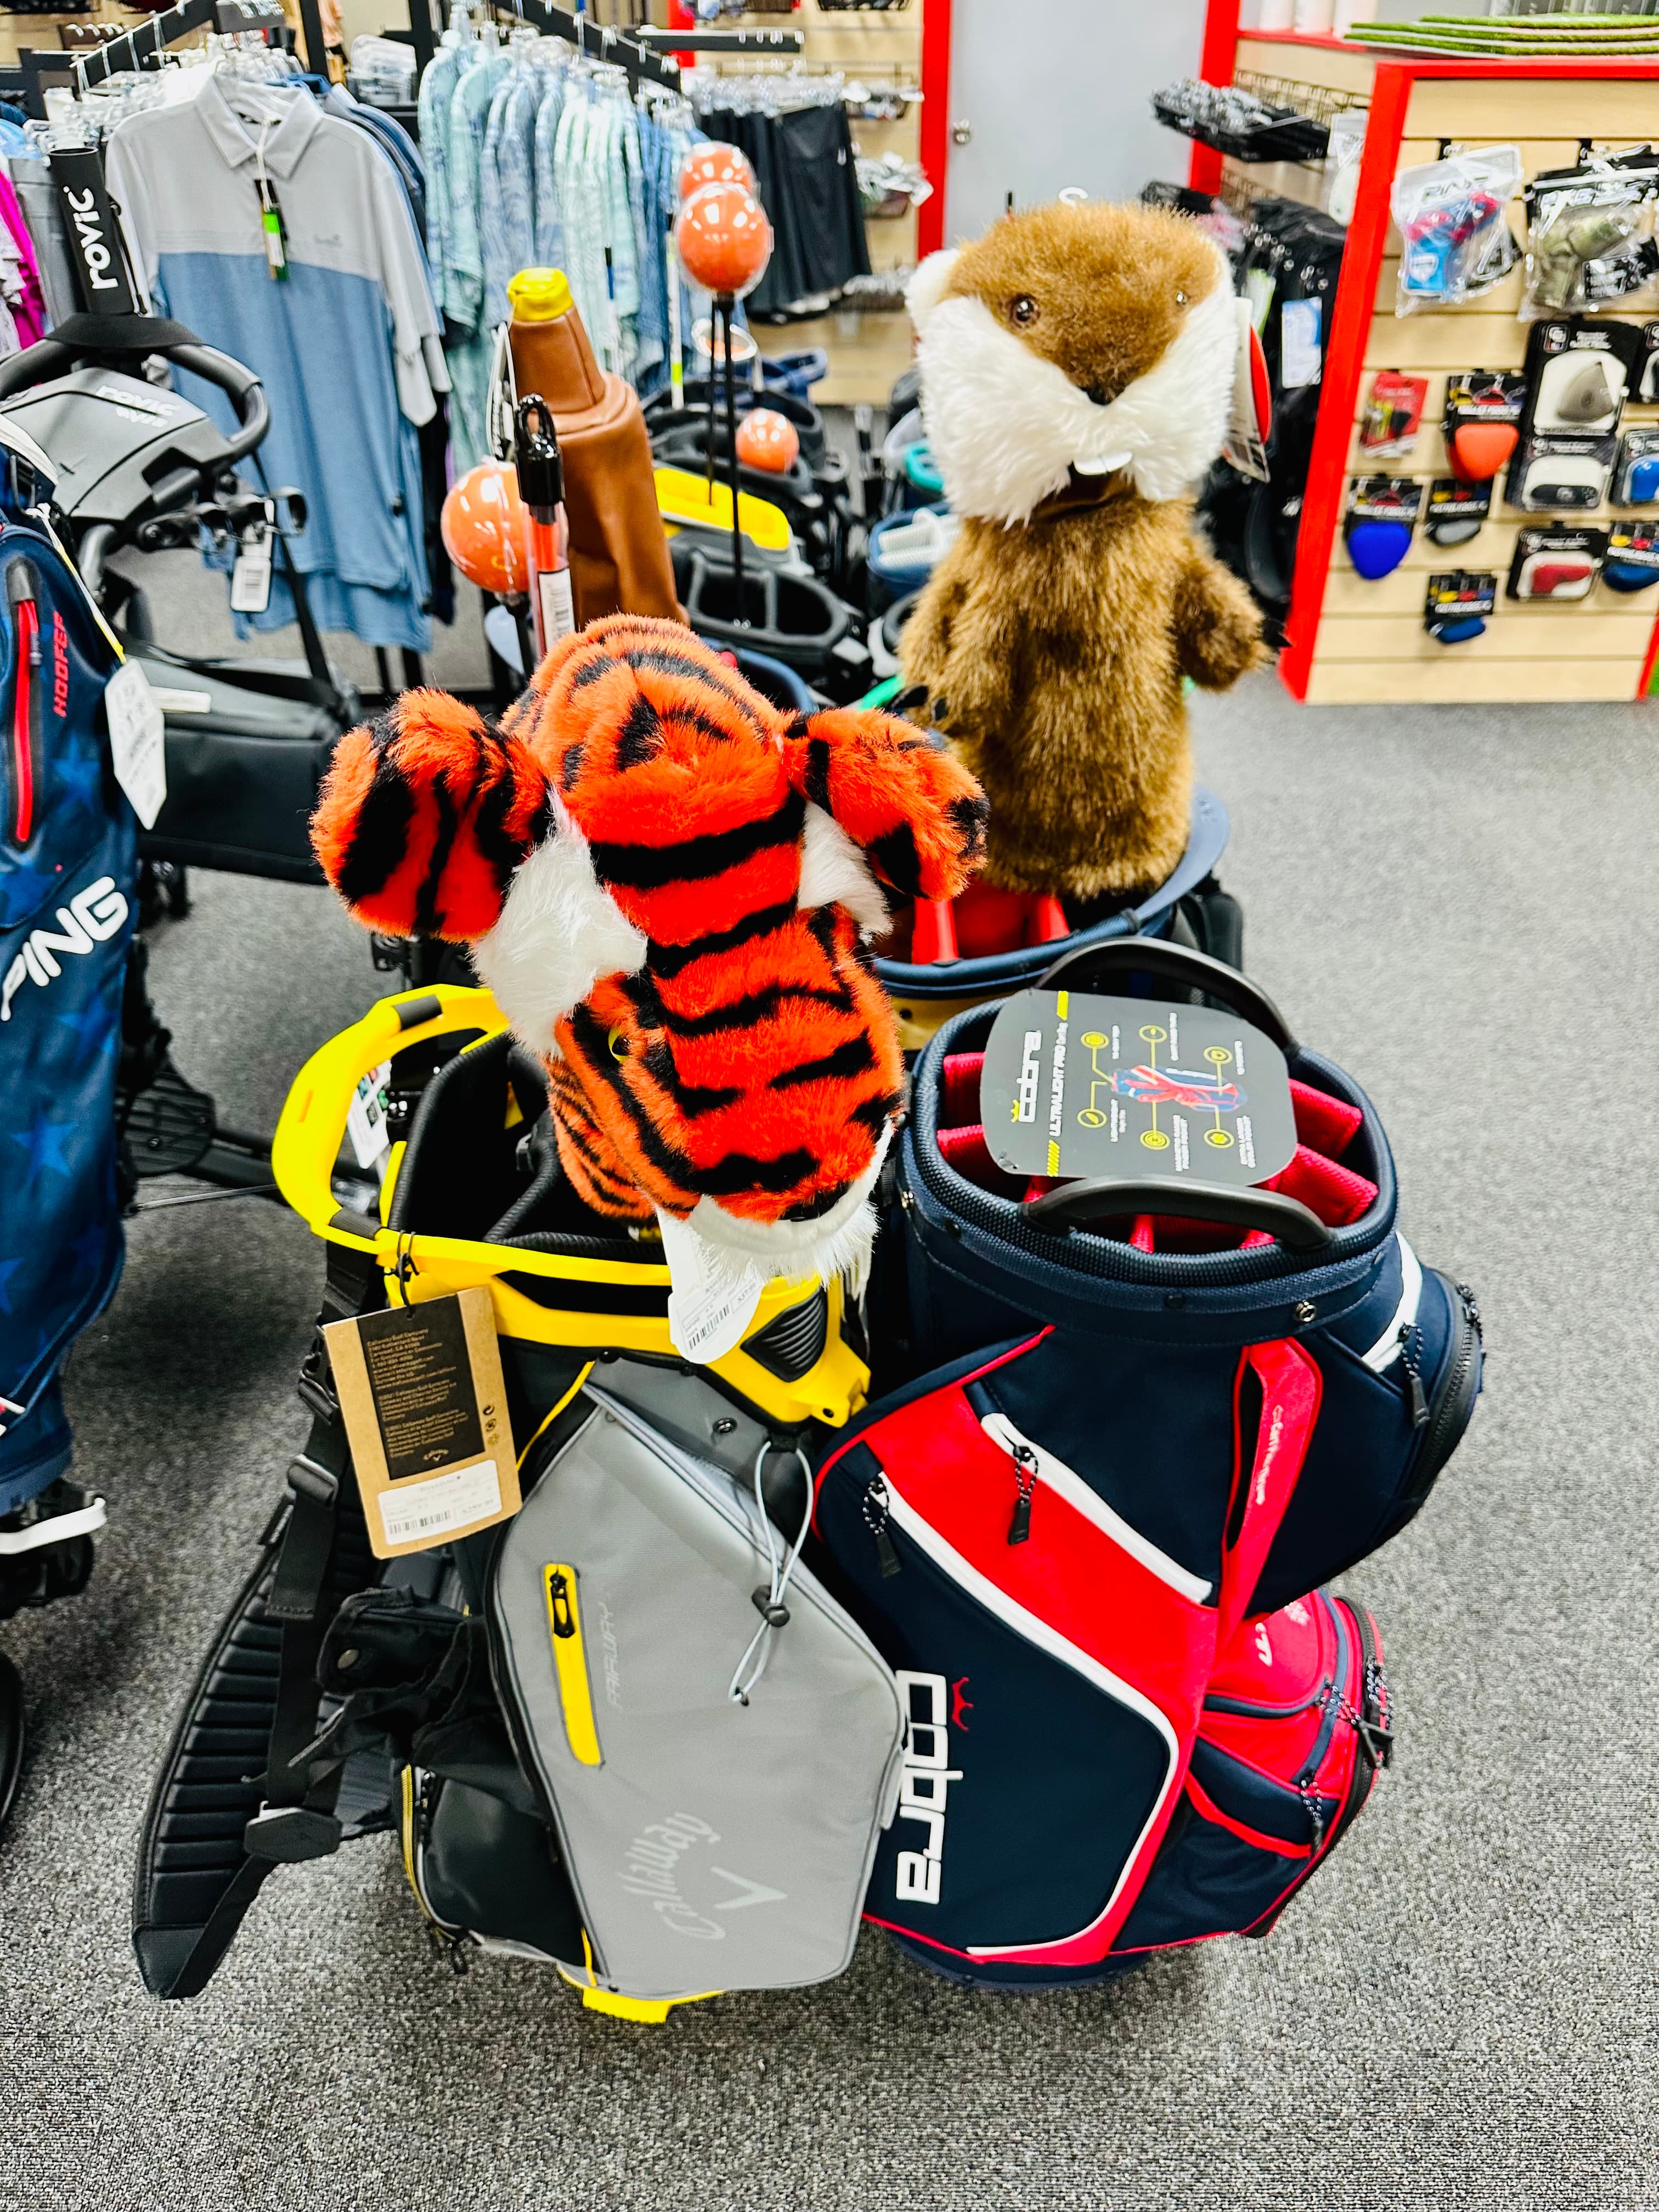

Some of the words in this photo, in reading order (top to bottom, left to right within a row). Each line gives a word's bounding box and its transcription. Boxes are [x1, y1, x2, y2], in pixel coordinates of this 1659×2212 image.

[63, 185, 119, 290] rovic
[1, 876, 129, 1022] PING
[1016, 1030, 1042, 1122] cobra
[896, 1669, 963, 1905] cobra
[617, 1811, 726, 1941] Callaway
